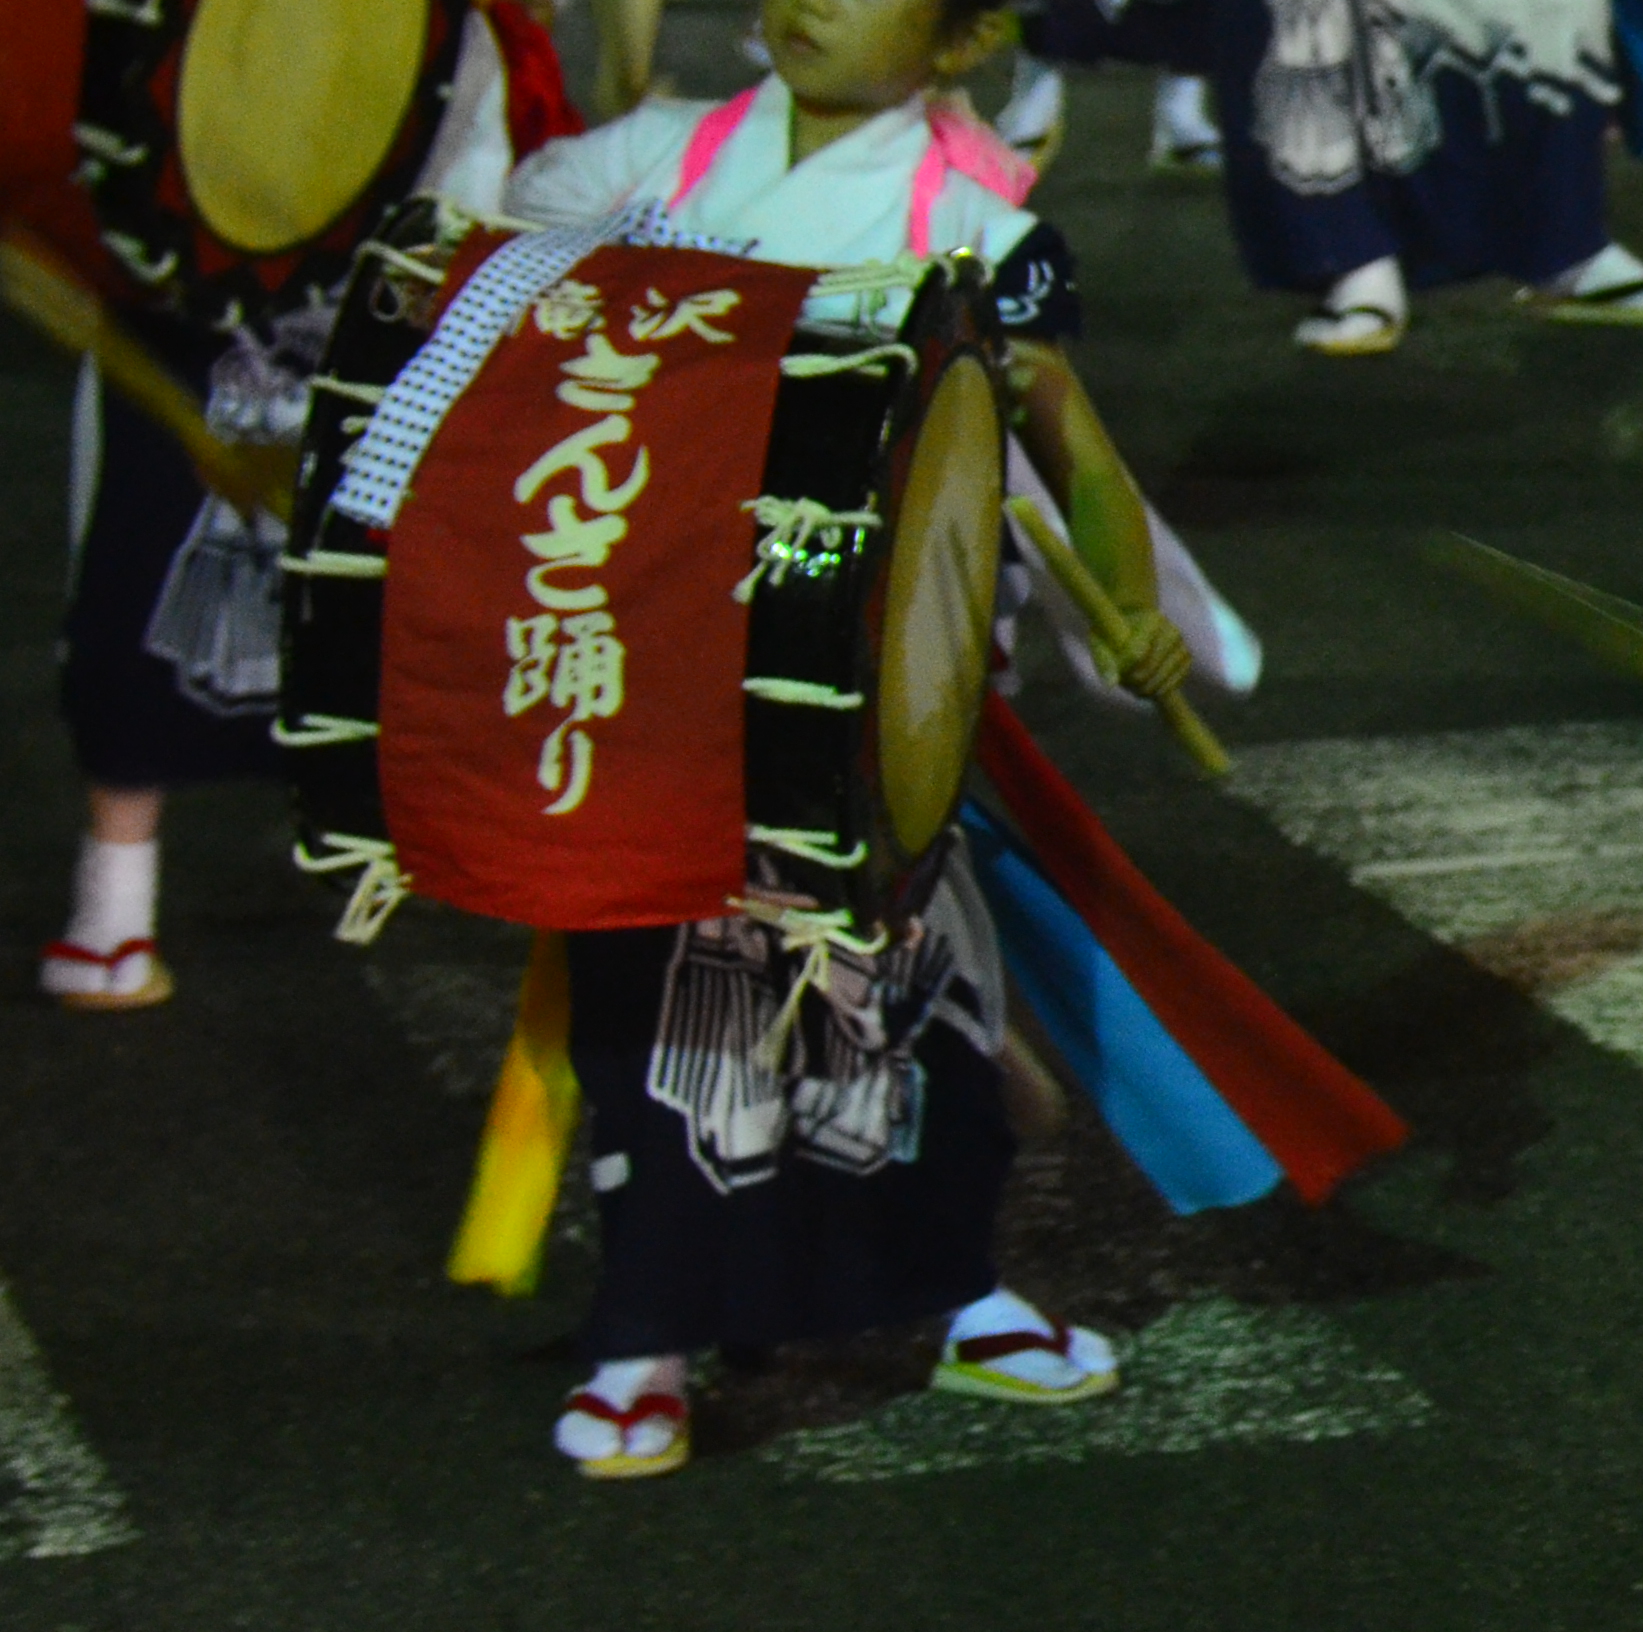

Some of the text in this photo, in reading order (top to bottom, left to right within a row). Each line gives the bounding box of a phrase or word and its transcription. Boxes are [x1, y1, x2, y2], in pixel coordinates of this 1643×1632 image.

[504, 333, 660, 816] さんさ踊り
